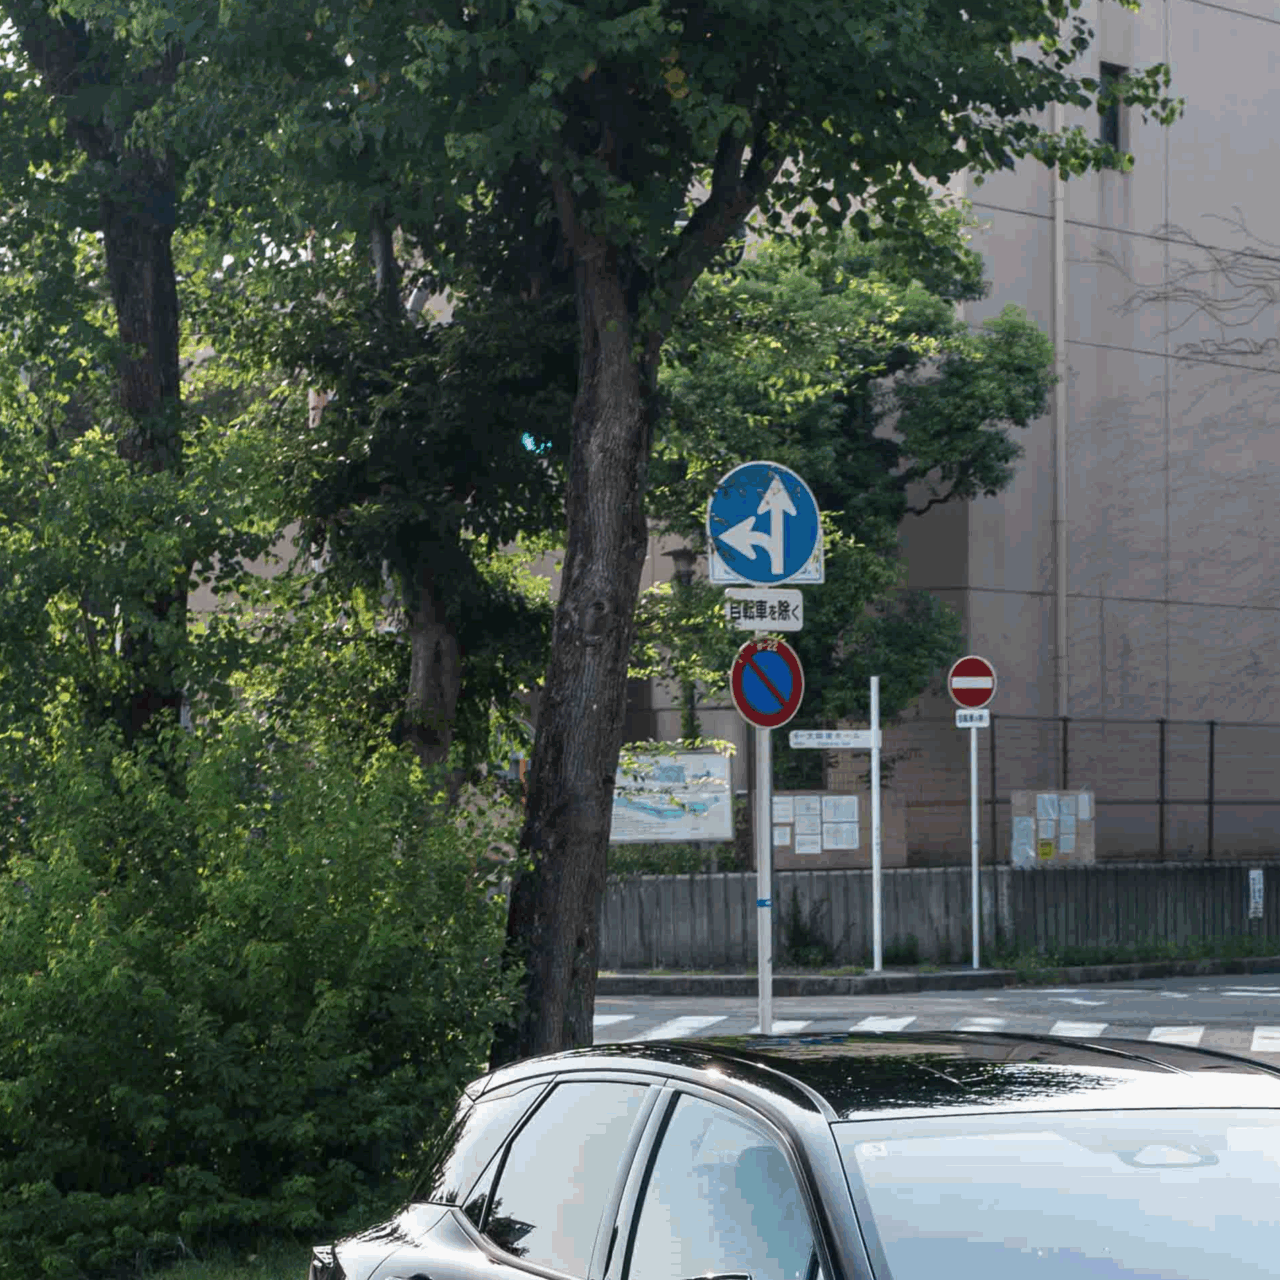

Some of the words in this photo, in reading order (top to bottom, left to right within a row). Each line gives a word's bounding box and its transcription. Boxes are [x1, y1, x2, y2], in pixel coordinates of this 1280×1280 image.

[730, 600, 800, 621] 自転車を除く
